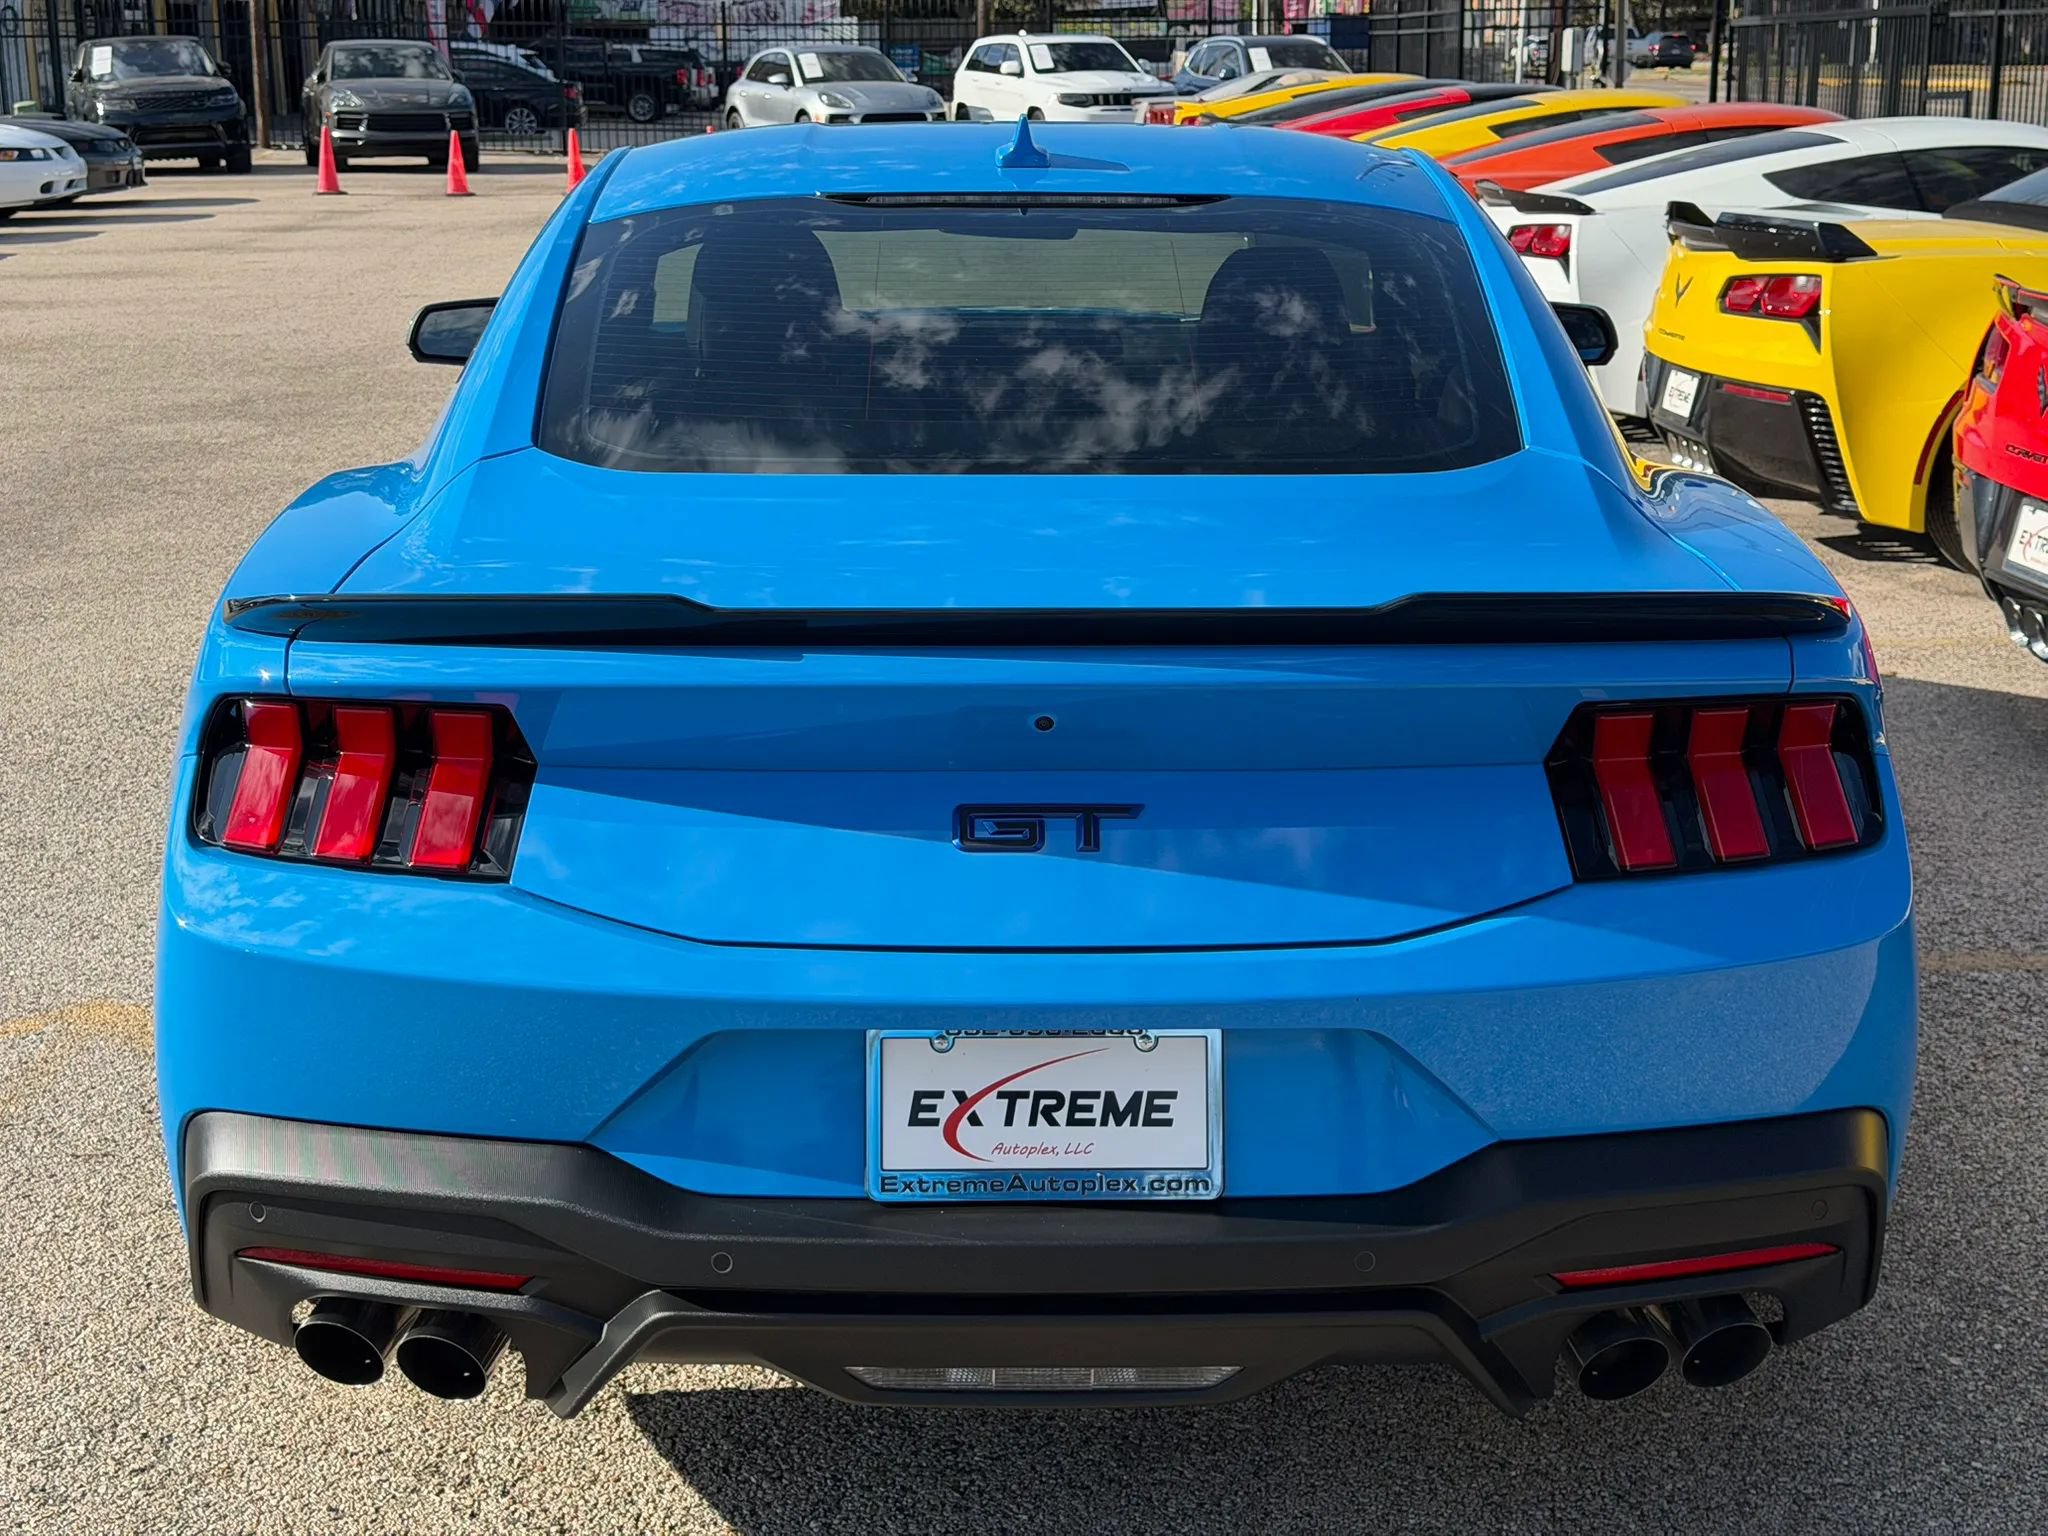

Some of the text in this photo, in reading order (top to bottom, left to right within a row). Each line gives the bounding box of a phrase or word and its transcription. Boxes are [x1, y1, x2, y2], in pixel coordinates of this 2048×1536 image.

[952, 803, 1145, 852] GT
[907, 1090, 1179, 1128] EXTREME
[991, 1142, 1095, 1159] Autoplex, LLC
[880, 1172, 1211, 1196] ExtremeAutoplex.com
